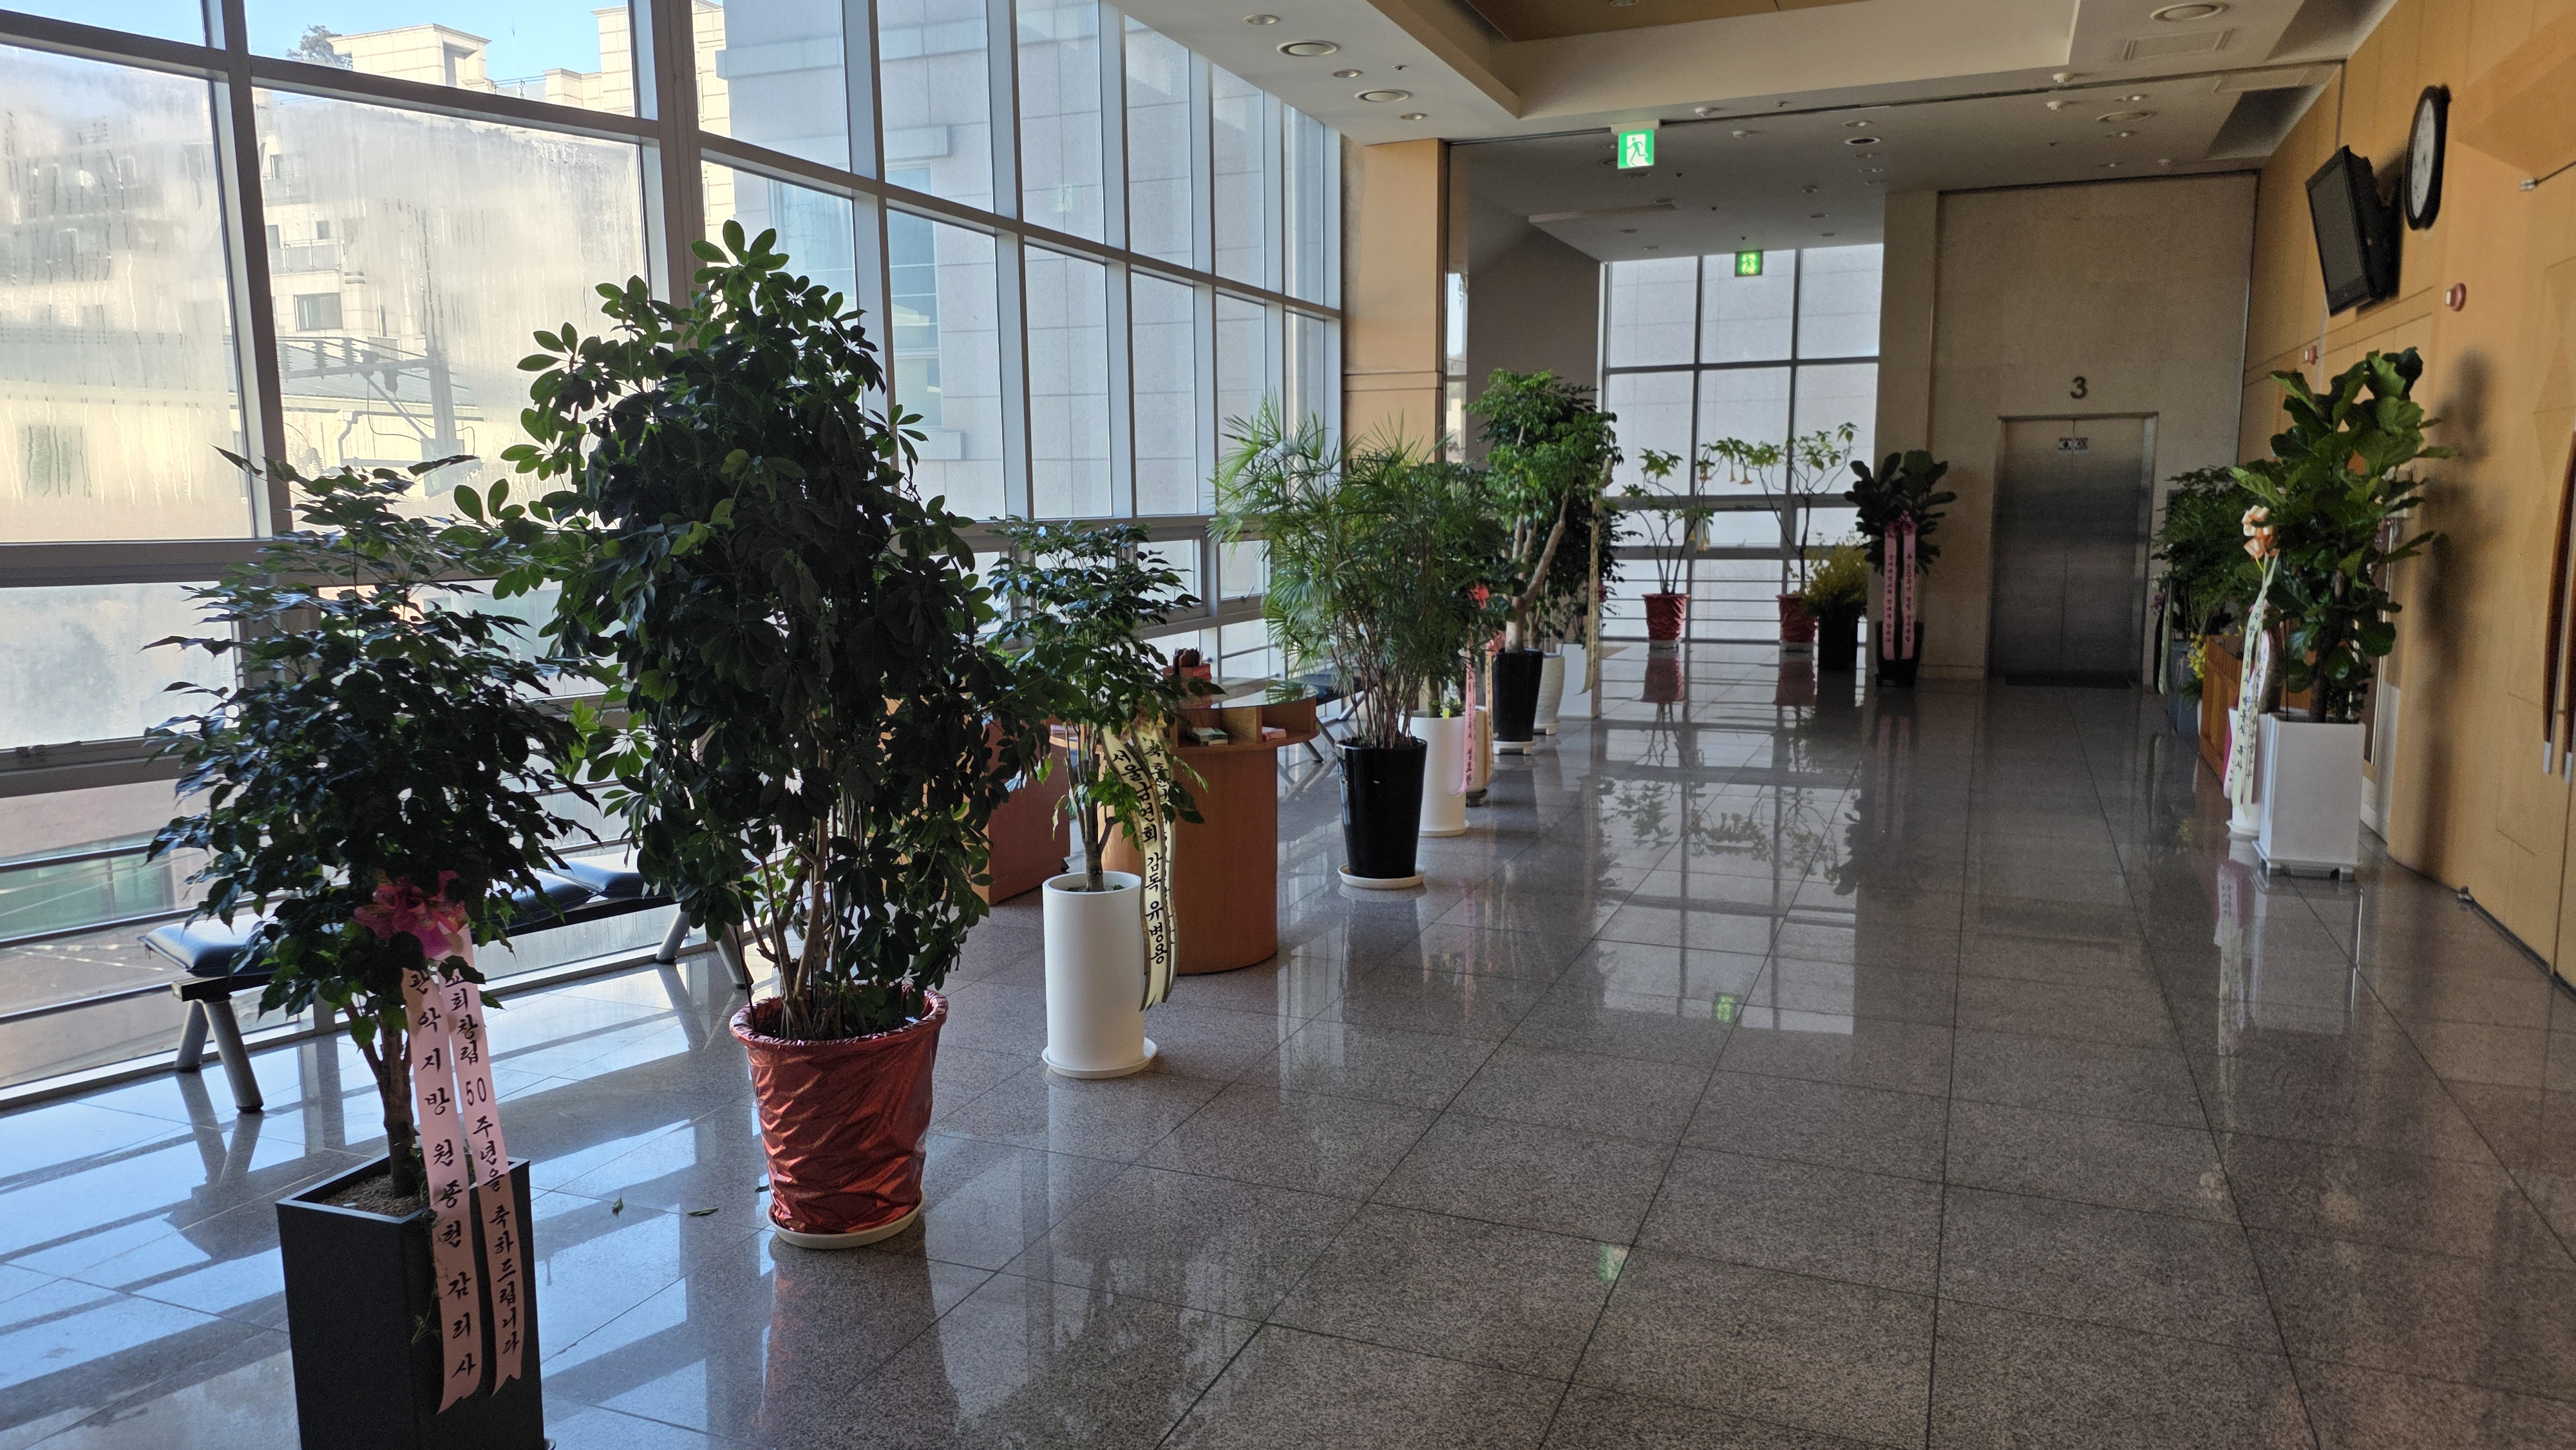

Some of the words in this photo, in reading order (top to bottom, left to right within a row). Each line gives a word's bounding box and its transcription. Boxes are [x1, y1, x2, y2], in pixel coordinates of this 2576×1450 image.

[2070, 376, 2088, 399] 3
[1144, 852, 1162, 892] 감독
[1145, 900, 1168, 965] 유병용
[409, 970, 450, 1115] 관악지방
[448, 1271, 477, 1379] 감리사
[489, 1204, 520, 1355] 축하드립니다
